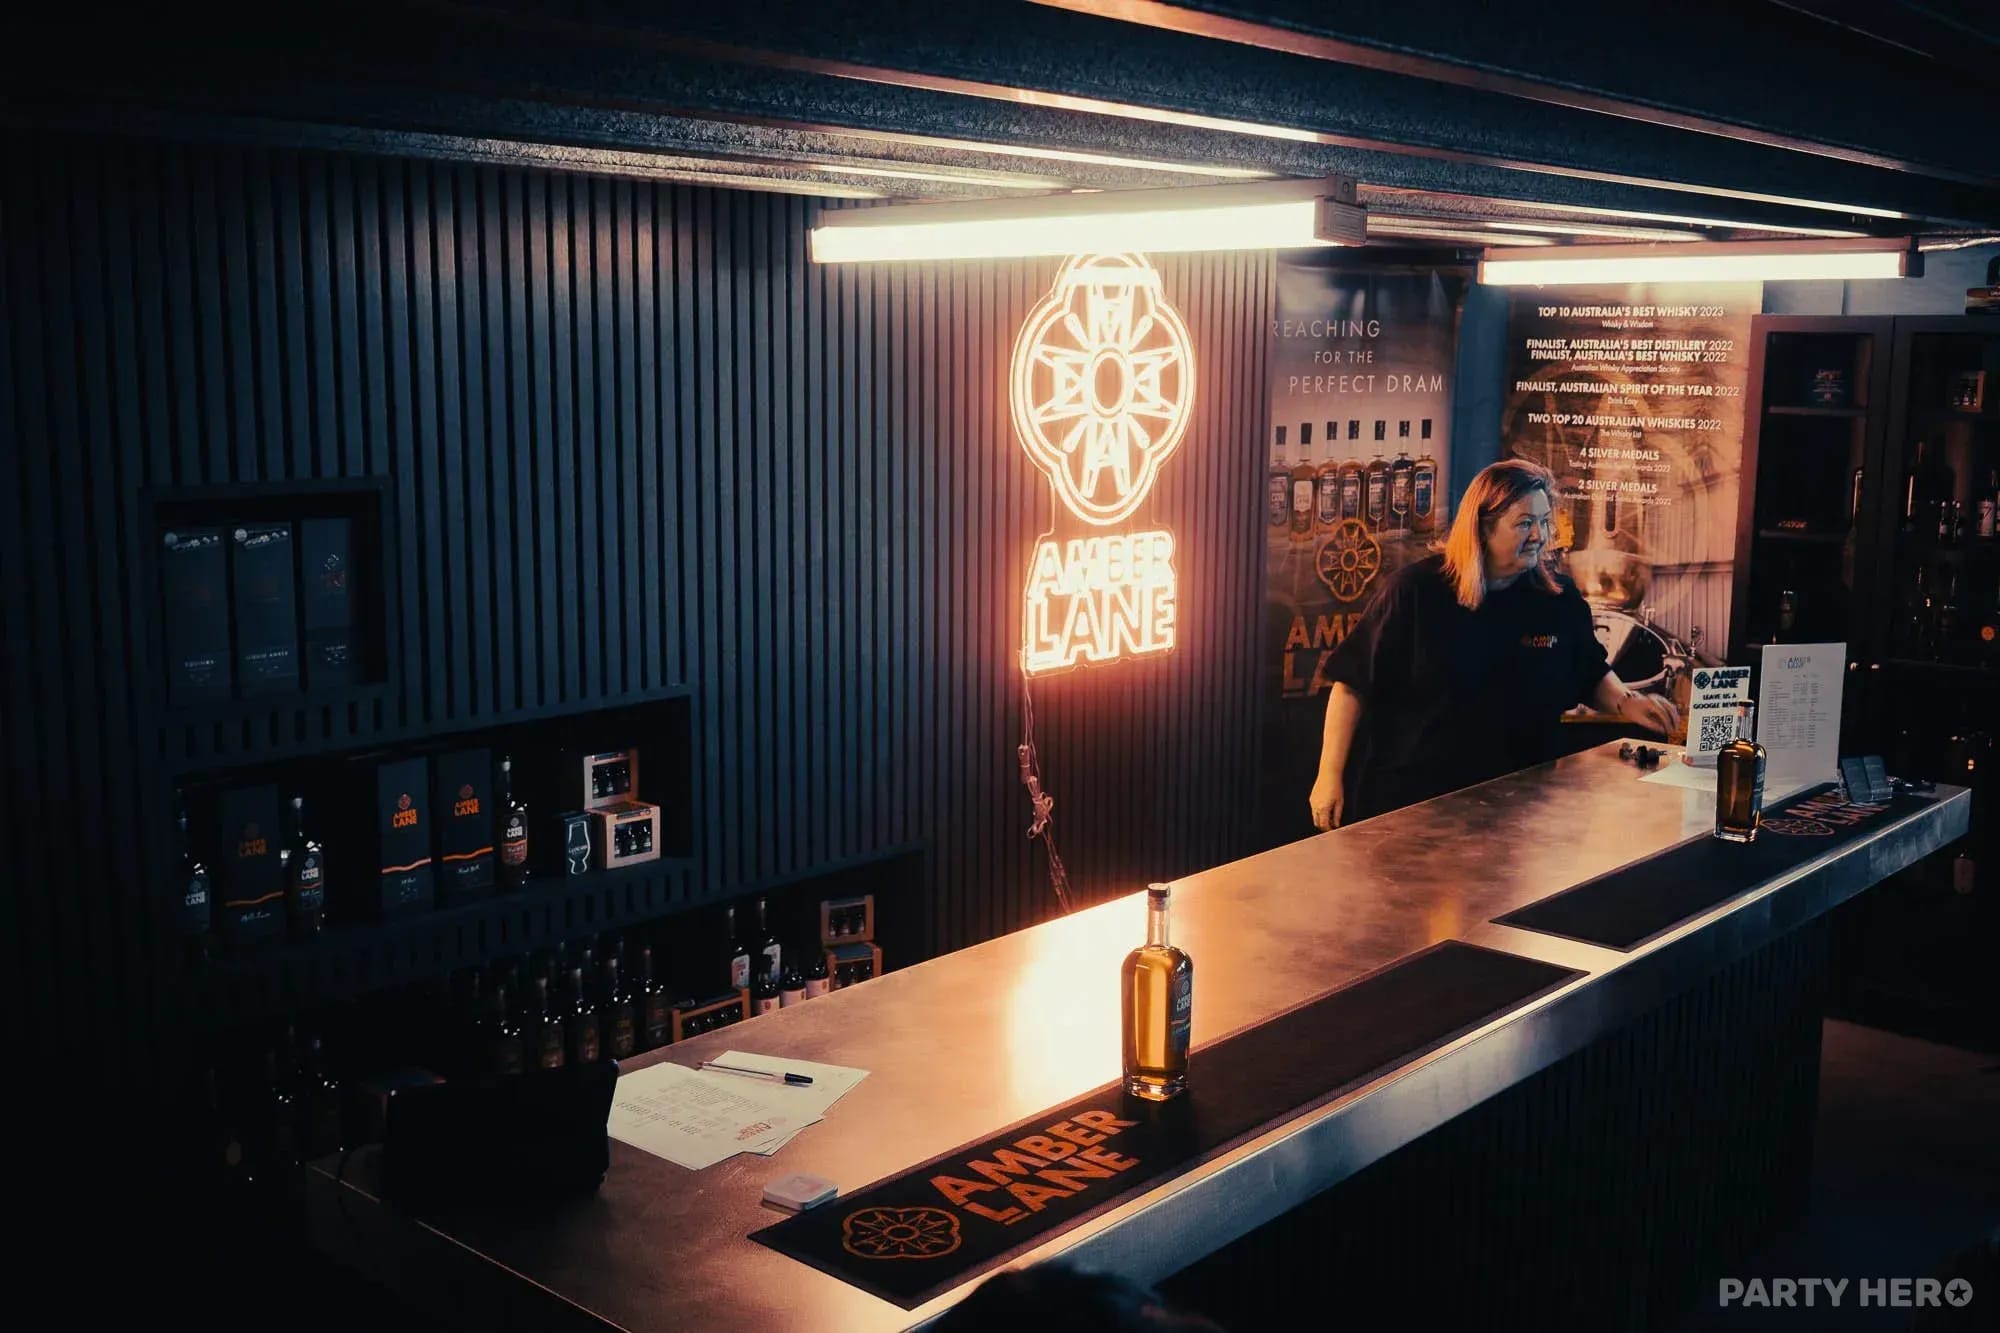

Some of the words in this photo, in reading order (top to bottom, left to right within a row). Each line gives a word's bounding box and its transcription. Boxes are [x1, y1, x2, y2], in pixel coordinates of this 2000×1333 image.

[1538, 306, 1557, 317] TOP
[1559, 306, 1570, 317] 10
[1571, 306, 1630, 318] AUSTRALIA'S
[1632, 306, 1655, 317] BEST
[1656, 306, 1698, 317] WHISKY
[1700, 306, 1724, 317] 2023
[1271, 320, 1380, 338] REACHING
[1601, 319, 1622, 330] Whisky
[1629, 319, 1654, 328] Wisdom
[1526, 339, 1568, 350] FINALIST,
[1569, 339, 1629, 350] AUSTRALIA'S
[1631, 339, 1654, 350] BEST
[1654, 340, 1708, 350] DISTILLERY
[1708, 340, 1734, 351] 2022
[1314, 351, 1341, 364] FOR
[1348, 351, 1373, 364] THE
[1531, 350, 1572, 361] FINALIST,
[1573, 350, 1634, 361] AUSTRALIA'S
[1636, 351, 1658, 361] BEST
[1659, 351, 1702, 362] WHISKY
[1702, 352, 1727, 362] 2022
[1289, 375, 1376, 395] PERFECT
[1387, 374, 1443, 393] DRAM
[1516, 382, 1558, 393] FINALIST,
[1559, 382, 1618, 393] AUSTRALIAN
[1619, 383, 1650, 394] SPIRIT
[1650, 384, 1665, 395] OF
[1666, 385, 1685, 395] THE
[1686, 385, 1713, 396] YEAR
[1714, 386, 1740, 397] 2022
[1528, 413, 1550, 424] TWO
[1552, 414, 1571, 424] TOP
[1571, 414, 1584, 425] 20
[1585, 415, 1646, 427] AUSTRALIAN
[1647, 417, 1696, 429] WHISKIES
[1697, 419, 1722, 430] 2022
[1579, 447, 1587, 457] 4
[1588, 447, 1620, 458] SILVER
[1621, 449, 1660, 461] MEDALS
[1578, 479, 1585, 490] 2
[1586, 480, 1618, 491] SILVER
[1619, 481, 1657, 493] MEDALS
[1027, 531, 1174, 595] AMBER
[1026, 586, 1174, 668] LANE
[1713, 669, 1749, 680] AMBER
[1711, 679, 1739, 689] LANE
[929, 1110, 1141, 1206] AMBER
[962, 1145, 1141, 1226] LANE
